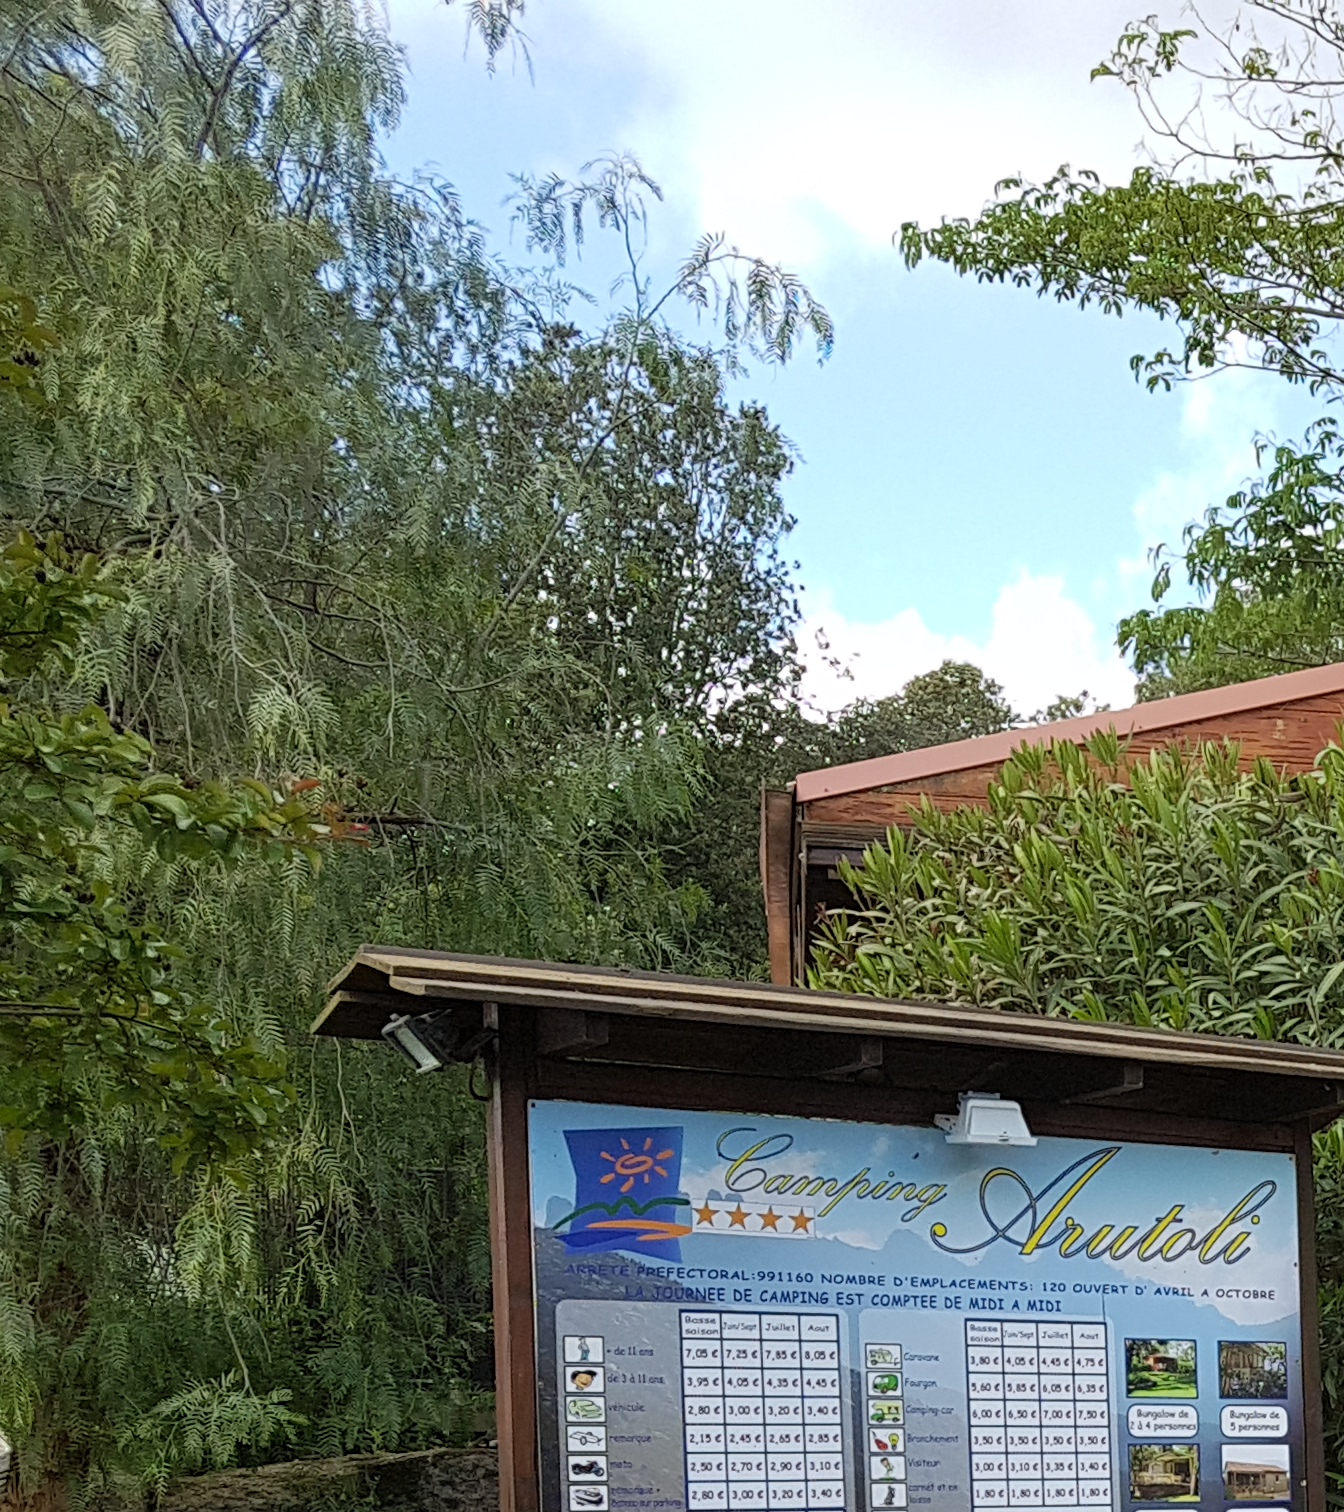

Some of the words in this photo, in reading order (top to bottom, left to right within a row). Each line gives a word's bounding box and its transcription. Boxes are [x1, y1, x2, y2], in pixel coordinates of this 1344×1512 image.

[716, 1128, 946, 1222] Camping
[930, 1146, 1277, 1265] Arutoli
[564, 1264, 630, 1277] ARRETE
[821, 1273, 886, 1286] NOMBRE
[893, 1276, 1033, 1292] D'EMPLACEMENTS:
[1043, 1282, 1066, 1292] 120
[1072, 1283, 1128, 1294] OUVERT
[1154, 1287, 1194, 1297] AVRIL
[1201, 1289, 1209, 1297] A
[1216, 1288, 1275, 1300] OCTOBRE
[625, 1286, 644, 1298] LA
[652, 1286, 726, 1302] JOURNEE
[733, 1288, 752, 1302] DE
[759, 1290, 829, 1304] CAMPING
[836, 1292, 864, 1306] EST
[871, 1294, 937, 1308] COMPTEE
[944, 1296, 962, 1309] DE
[969, 1297, 1004, 1311] MIDI
[1011, 1300, 1020, 1311] A
[1027, 1300, 1062, 1312] MIDI
[685, 1316, 716, 1324] Basse
[764, 1323, 795, 1332] Juillet
[614, 1346, 625, 1356] de
[628, 1346, 636, 1356] 11
[686, 1348, 708, 1360] 7,05
[726, 1349, 748, 1360] 7,25
[765, 1350, 787, 1361] 7,85
[805, 1351, 826, 1361] 8,05
[903, 1352, 940, 1361] Caravane
[607, 1374, 619, 1383] de
[622, 1374, 627, 1383] 3
[638, 1374, 646, 1383] 11
[687, 1377, 709, 1388] 3,95
[727, 1377, 749, 1388] 4,05
[767, 1378, 788, 1389] 4,35
[806, 1378, 827, 1389] 4,45
[905, 1378, 938, 1390] Fourgon
[688, 1405, 710, 1416] 2,80
[728, 1405, 750, 1416] 3,00
[768, 1406, 790, 1417] 3,20
[807, 1406, 829, 1417] 3,40
[1136, 1409, 1176, 1420] Bungalow
[1178, 1409, 1189, 1418] de
[1229, 1410, 1267, 1421] Bungalow
[1269, 1410, 1280, 1419] de
[1137, 1421, 1143, 1430] à
[1146, 1422, 1151, 1430] 4
[1153, 1423, 1197, 1432] personnes
[1238, 1423, 1280, 1433] personnes
[690, 1434, 711, 1445] 2,15
[730, 1434, 751, 1444] 2,45
[769, 1434, 791, 1444] 2,65
[808, 1434, 830, 1444] 2,85
[907, 1434, 959, 1443] Branchement
[691, 1462, 713, 1473] 2,50
[731, 1462, 753, 1473] 2,70
[770, 1461, 792, 1472] 2,90
[810, 1461, 831, 1472] 3,10
[692, 1490, 714, 1501] 2,80
[732, 1490, 754, 1501] 3,00
[772, 1489, 793, 1501] 3,20
[811, 1489, 832, 1499] 3,40
